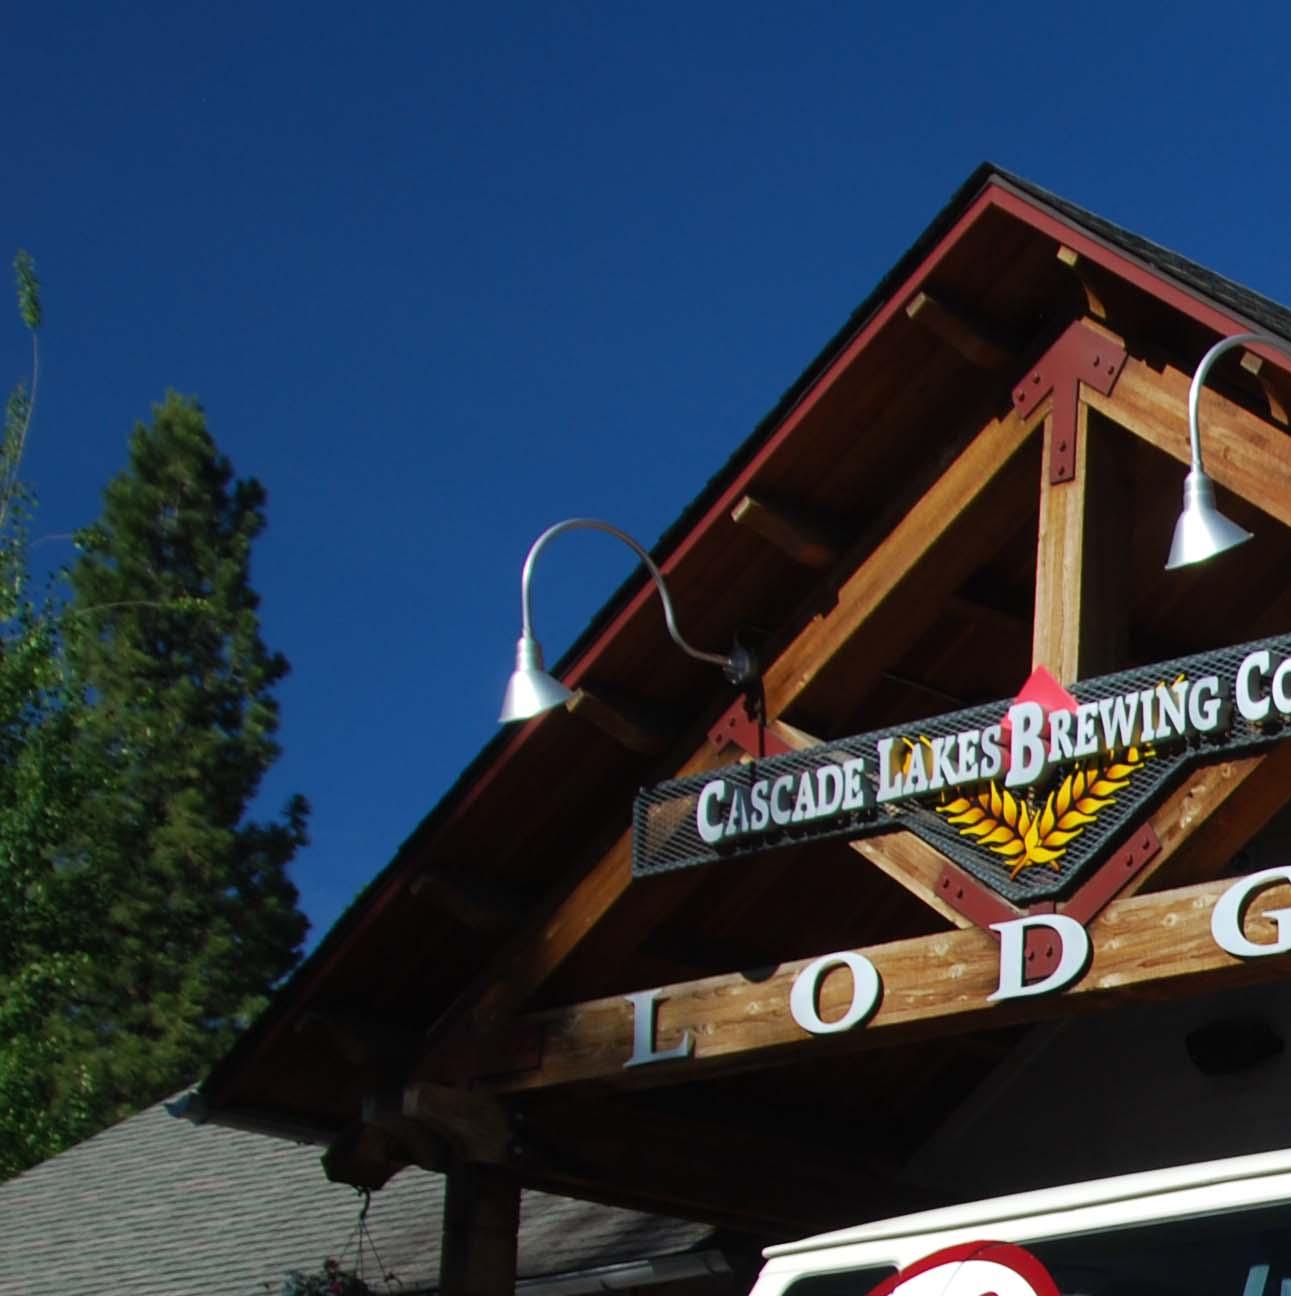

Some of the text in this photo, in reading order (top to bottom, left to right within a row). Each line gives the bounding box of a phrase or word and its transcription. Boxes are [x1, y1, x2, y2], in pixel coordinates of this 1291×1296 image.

[696, 758, 865, 843] CASCADE
[876, 728, 1002, 802] LAKES
[1005, 677, 1222, 787] BREWING
